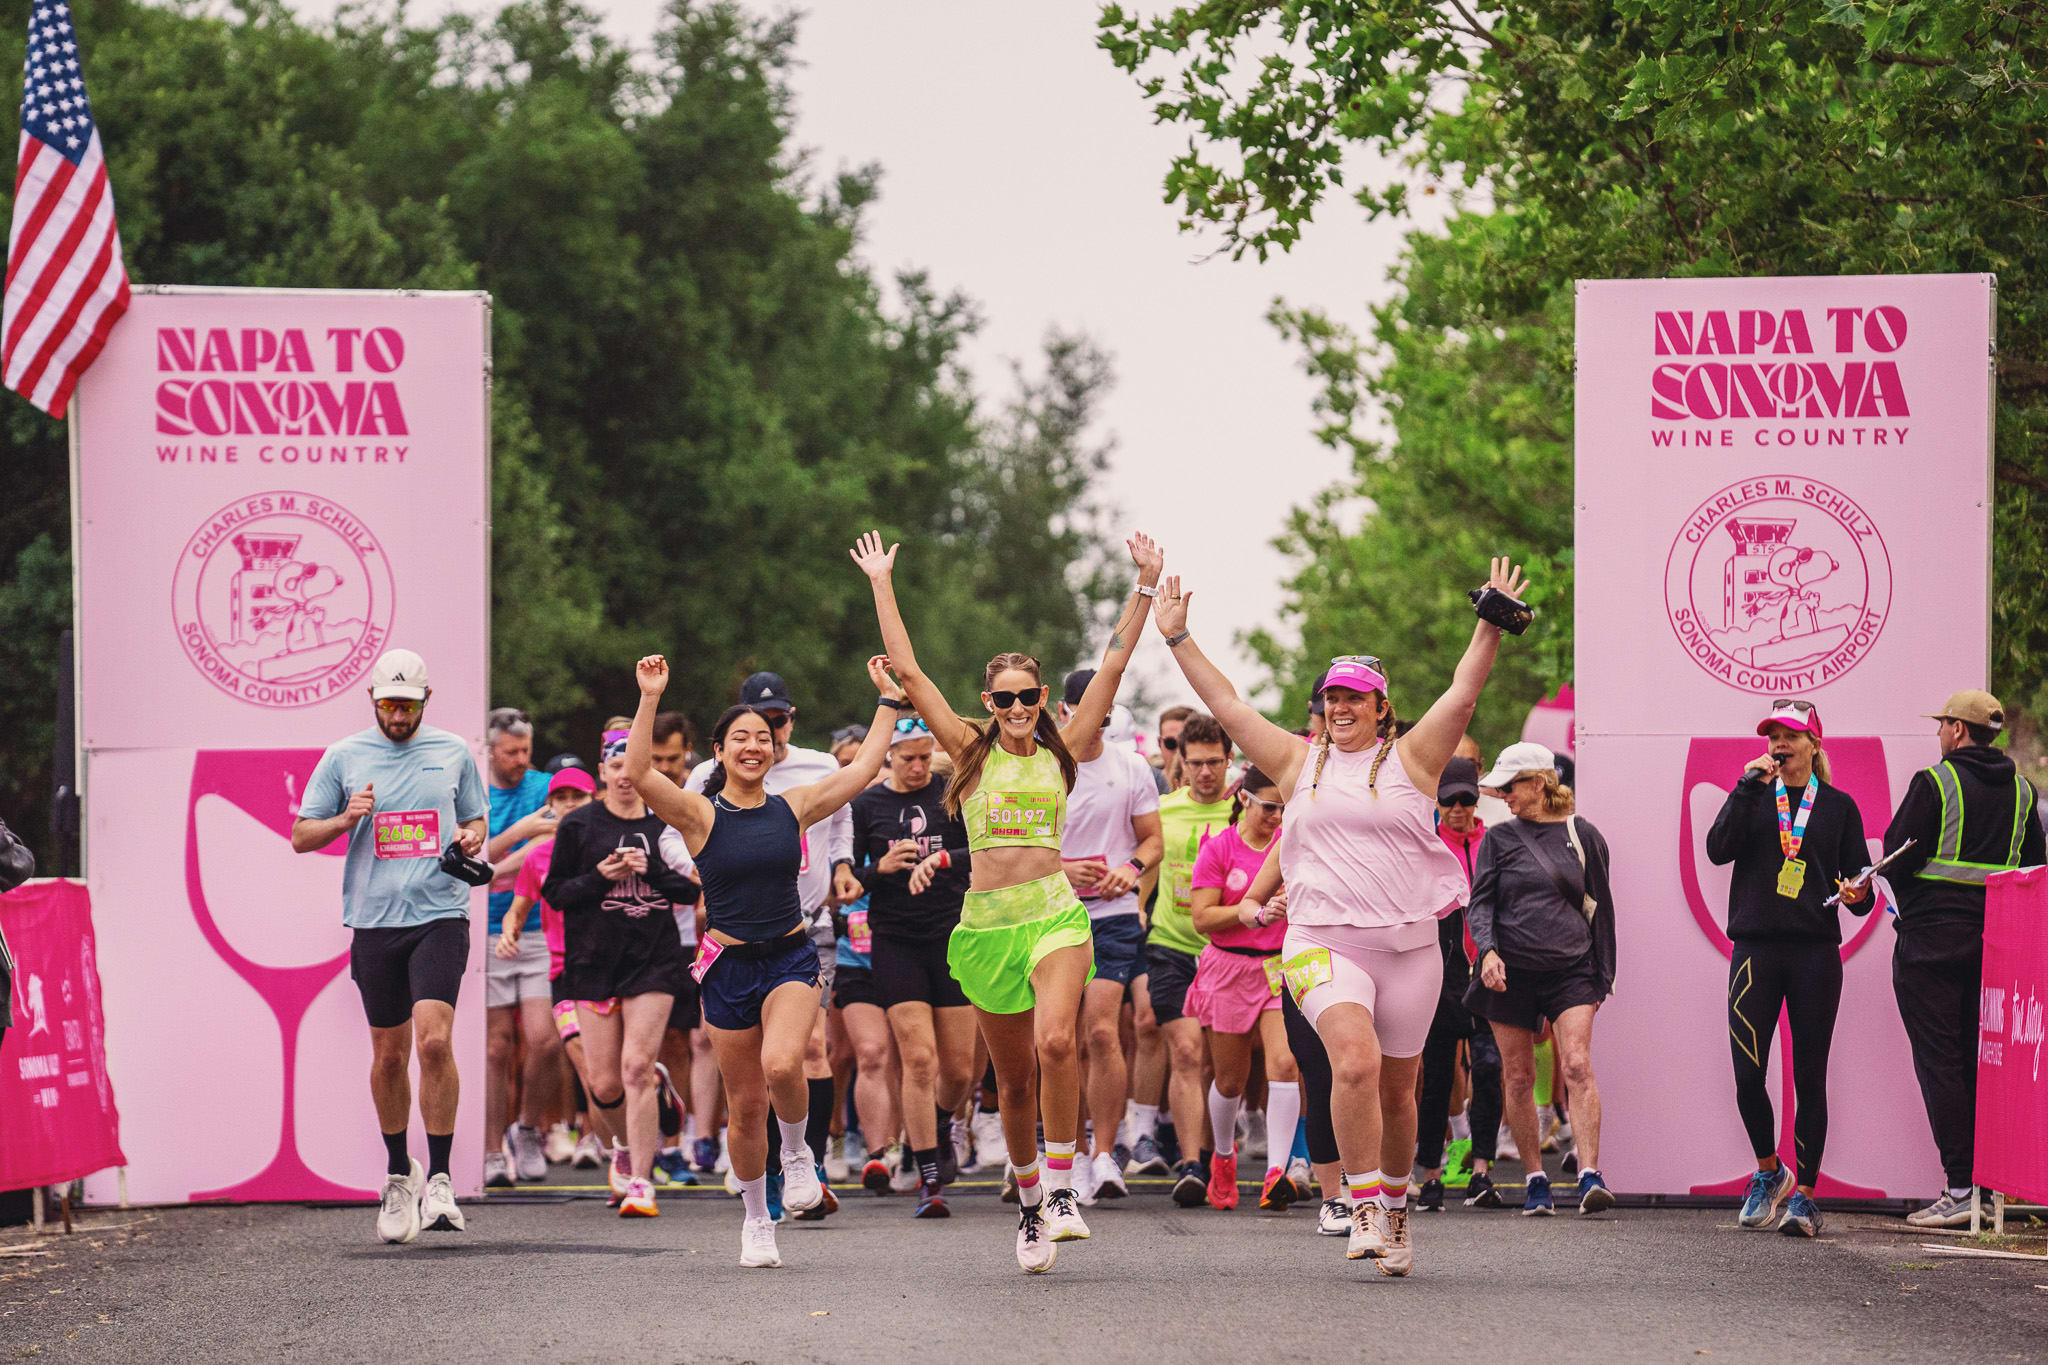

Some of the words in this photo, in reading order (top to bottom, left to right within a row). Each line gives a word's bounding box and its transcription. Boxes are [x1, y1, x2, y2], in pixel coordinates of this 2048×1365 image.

[158, 328, 315, 372] NAPA
[326, 327, 405, 373] TO
[1655, 309, 1814, 355] NAPA
[1827, 305, 1908, 354] TO
[156, 379, 409, 436] SONOMA
[1651, 361, 1911, 420] SONOMA
[156, 445, 239, 463] WINE
[259, 445, 409, 463] COUNTRY
[1651, 429, 1734, 447] WINE
[1755, 427, 1910, 446] COUNTRY
[192, 497, 273, 559] CHARLES
[280, 497, 299, 511] M.
[306, 500, 376, 557] SCHULZ
[1686, 481, 1768, 543] CHARLES
[1775, 480, 1795, 496] M.
[1802, 484, 1873, 542] SCHULZ
[183, 622, 240, 692] SONOMA
[244, 683, 323, 704] COUNTY
[328, 623, 385, 693] AIRPORT
[1675, 608, 1732, 679] SONOMA
[1736, 669, 1816, 691] COUNTY
[1822, 608, 1881, 680] AIRPORT
[378, 823, 426, 843] 2656
[990, 807, 1047, 824] 50197
